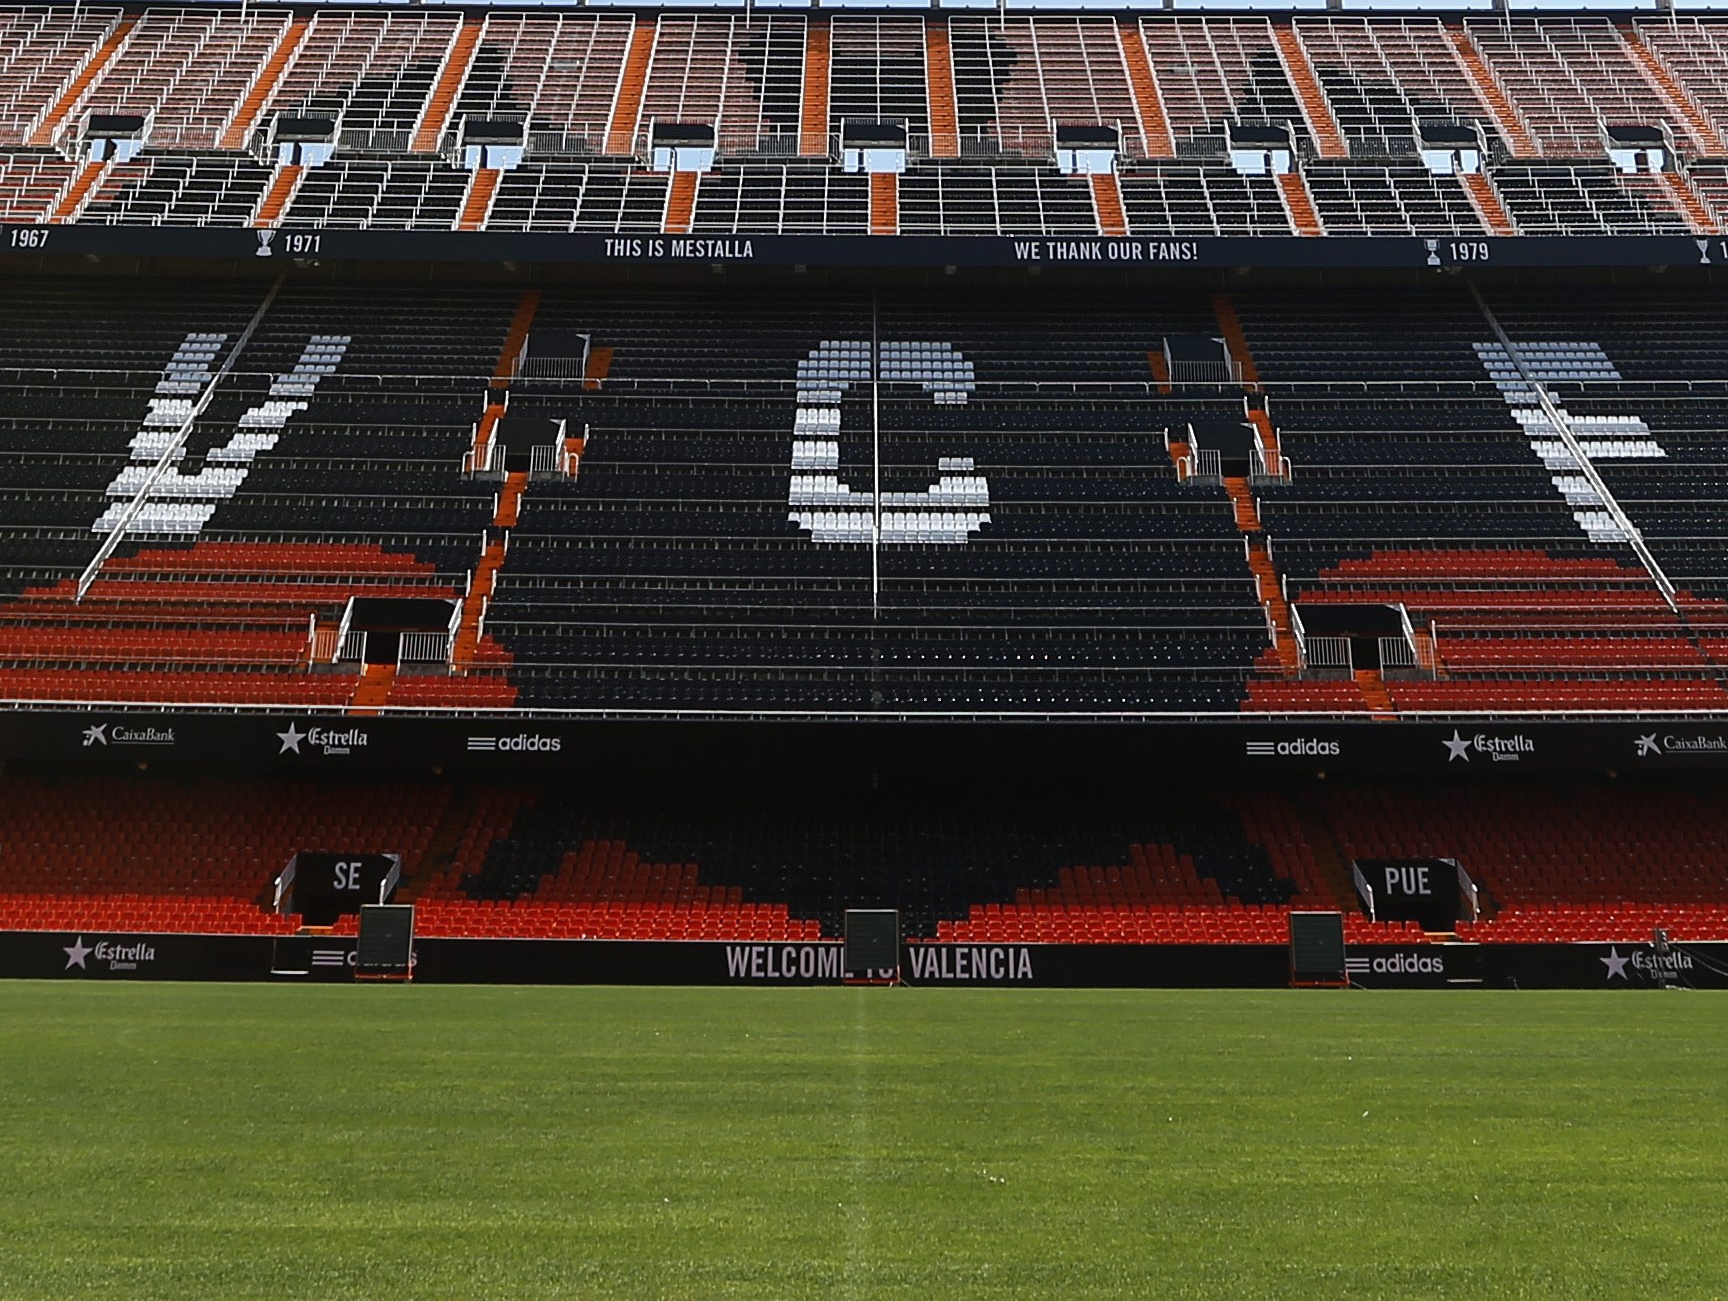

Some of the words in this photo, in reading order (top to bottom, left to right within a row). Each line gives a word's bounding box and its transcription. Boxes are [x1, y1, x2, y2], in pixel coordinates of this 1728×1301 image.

[12, 230, 49, 247] 1967
[286, 235, 320, 252] 1971
[605, 239, 641, 256] THIS
[649, 240, 663, 256] IS
[672, 240, 752, 257] MESTALLA
[1015, 242, 1040, 259] WE
[1047, 242, 1101, 259] THANK
[1109, 242, 1142, 259] OUR
[1149, 243, 1197, 259] FANS!
[1450, 243, 1488, 260] 1979
[112, 727, 174, 740] CaixaBank
[308, 728, 367, 745] Estrella
[499, 734, 560, 751] adidas
[1278, 738, 1339, 754] adidas
[1474, 735, 1534, 752] Estrella
[1664, 736, 1727, 749] CaixaBank
[334, 862, 362, 889] SE
[1385, 867, 1431, 894] PUE
[95, 942, 154, 963] Estrella
[1631, 949, 1694, 970] Estrella
[909, 947, 1032, 979] VALENCIA
[1373, 953, 1443, 972] adidas
